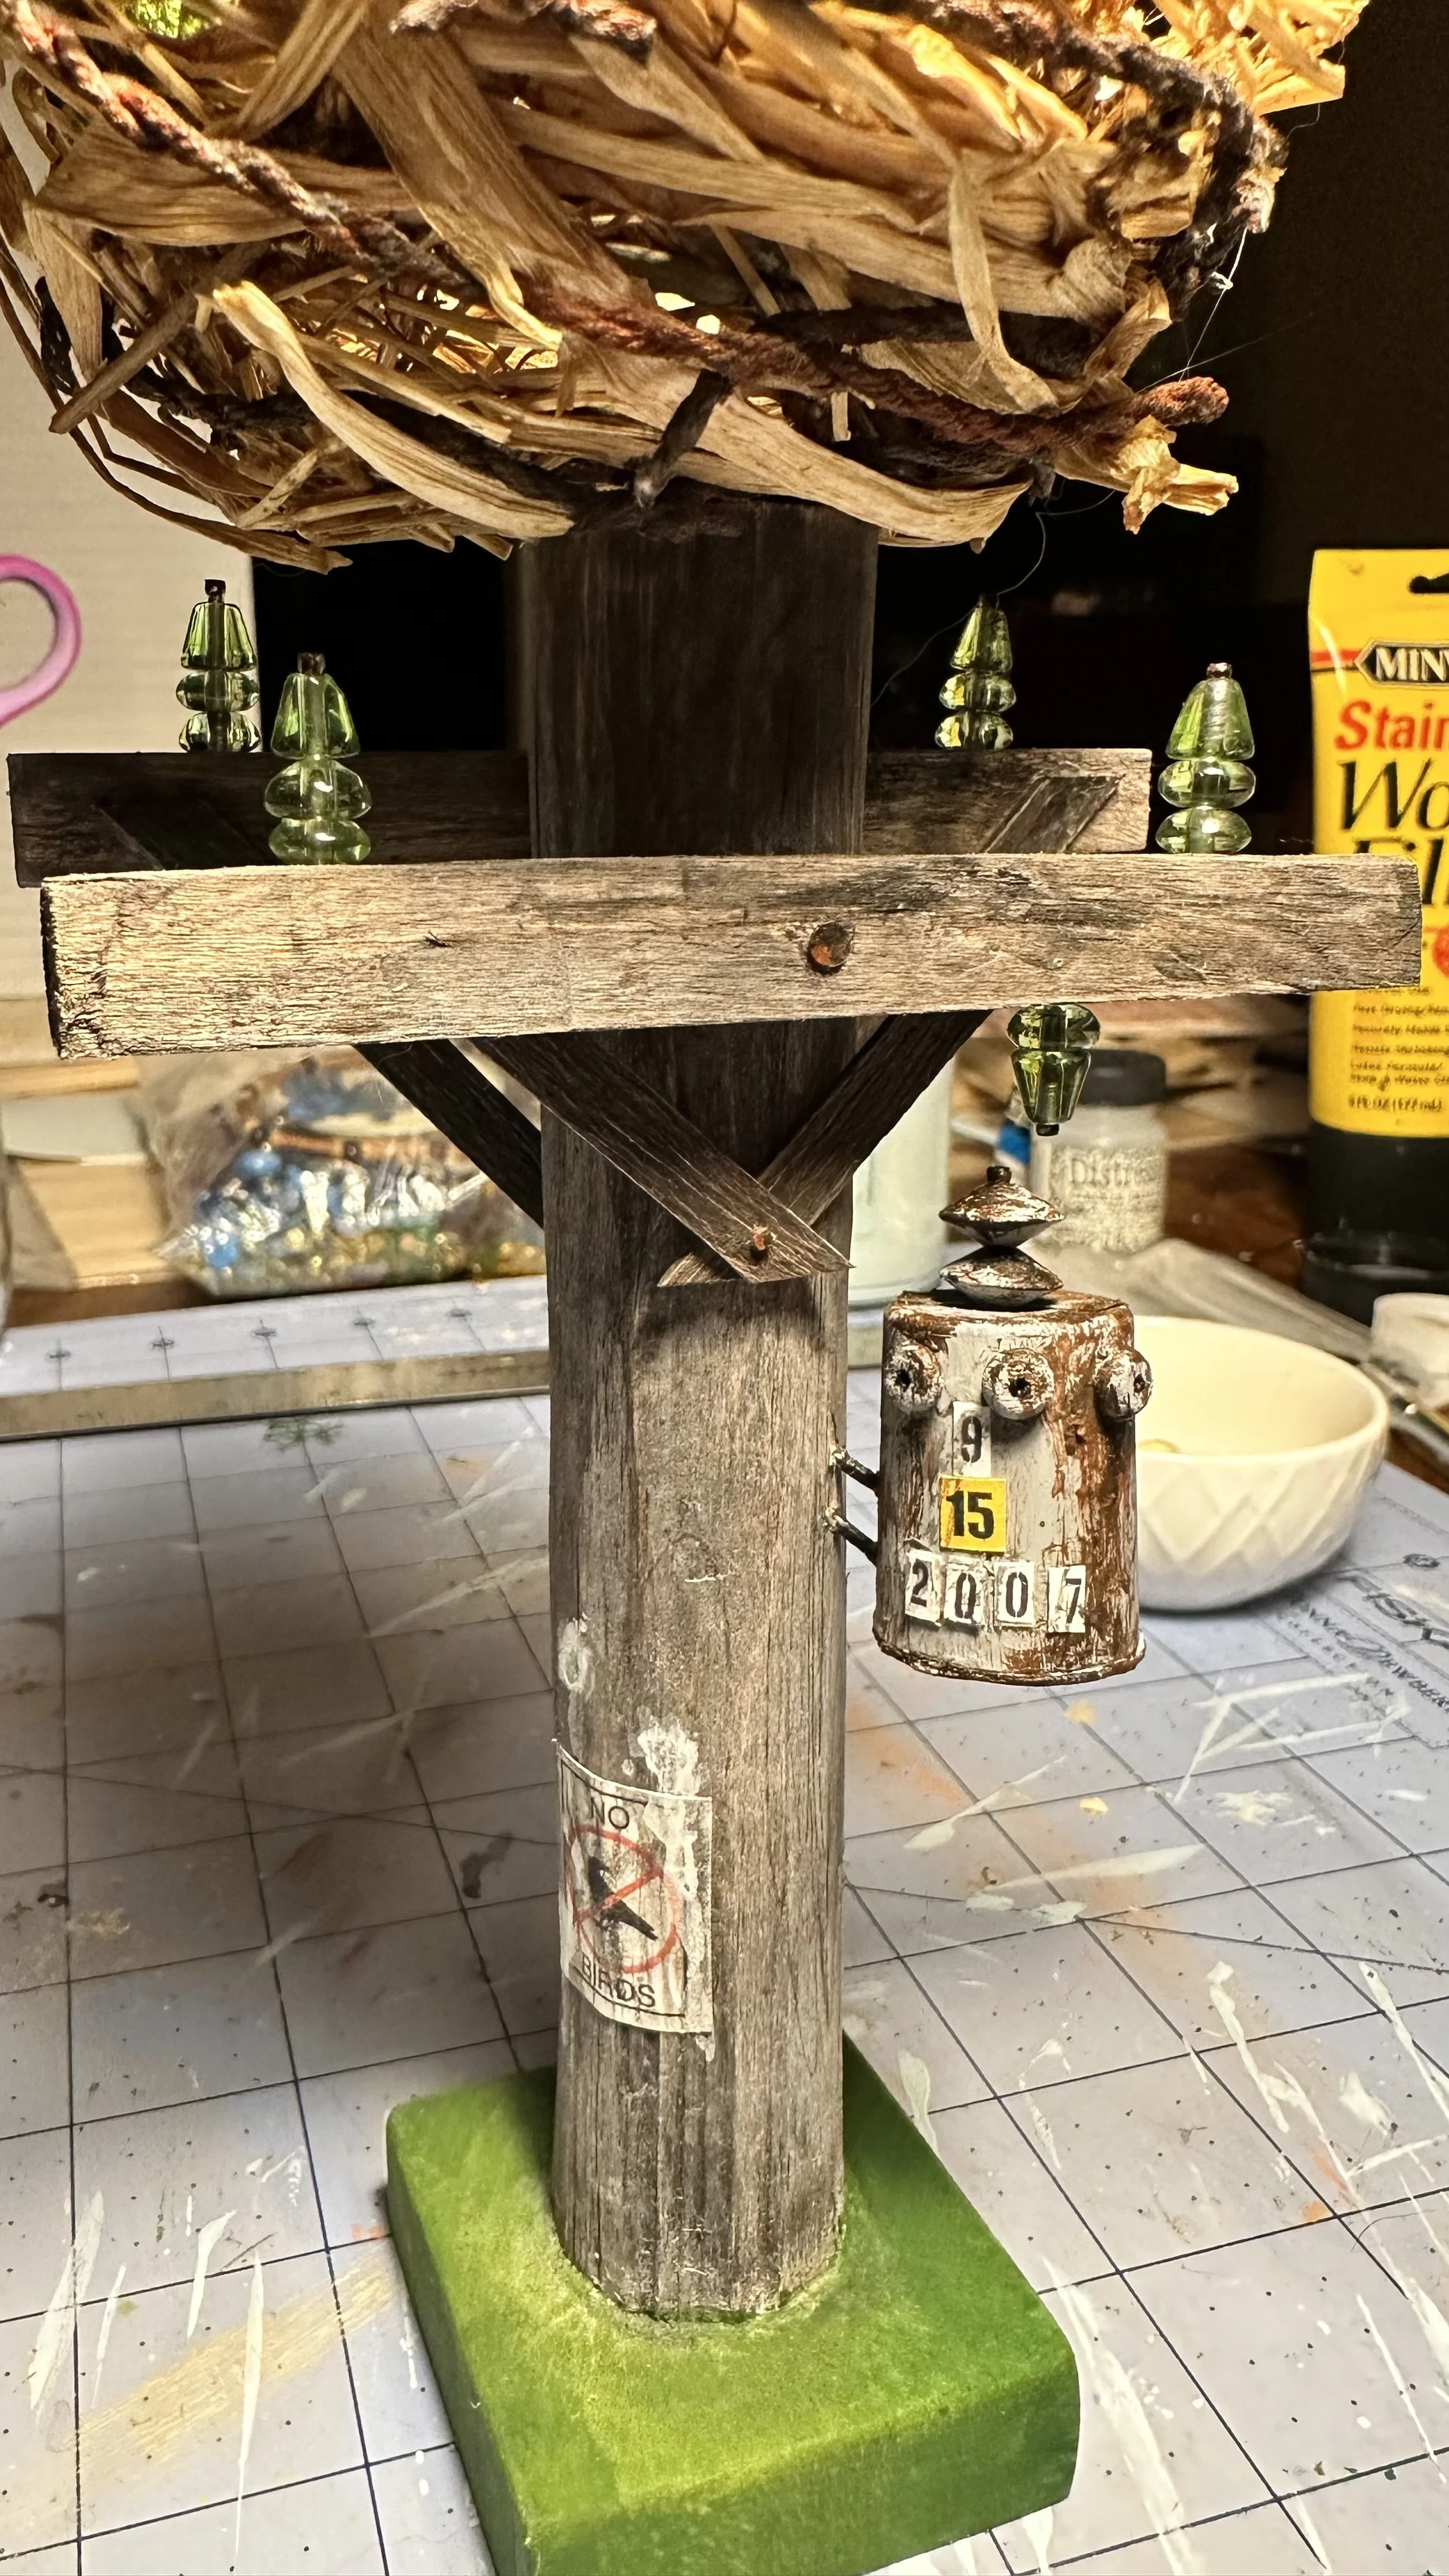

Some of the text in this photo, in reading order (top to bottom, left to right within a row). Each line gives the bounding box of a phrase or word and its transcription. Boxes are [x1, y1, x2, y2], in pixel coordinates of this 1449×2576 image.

[1376, 646, 1449, 682] MIN
[961, 1416, 983, 1463] 9
[946, 1490, 995, 1540] 15
[590, 1797, 630, 1829] NO
[581, 1951, 656, 2008] BIRDS
